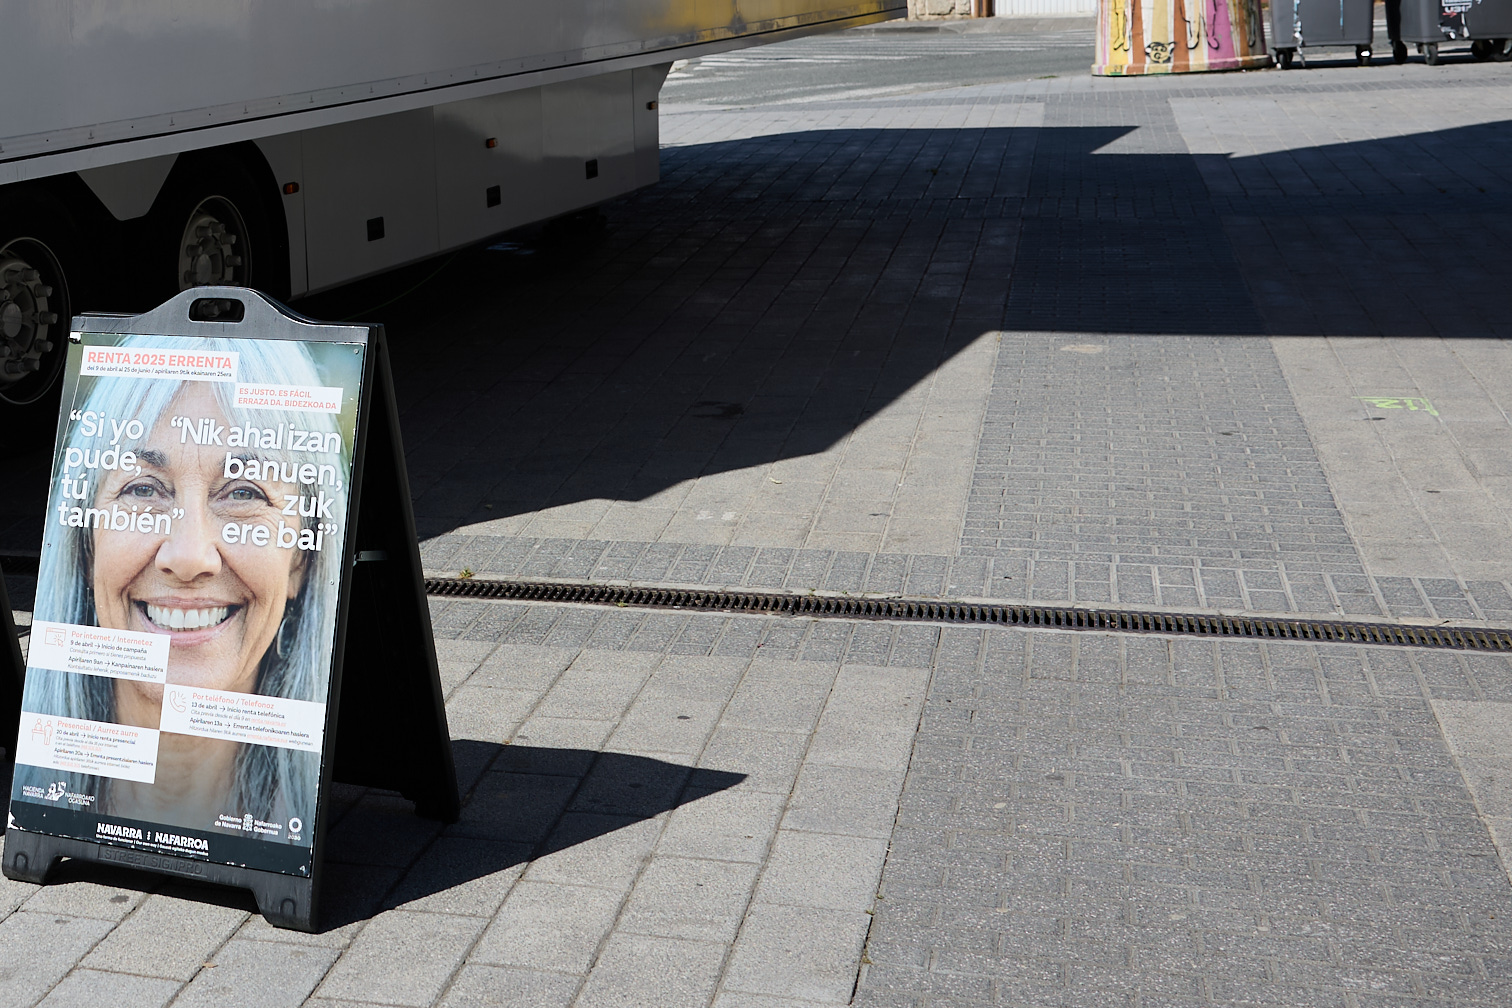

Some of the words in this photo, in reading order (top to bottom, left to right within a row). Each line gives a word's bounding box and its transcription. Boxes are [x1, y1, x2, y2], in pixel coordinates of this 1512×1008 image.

[88, 351, 131, 364] RENTA
[134, 353, 166, 366] 2025
[169, 354, 232, 369] ERRENTA
[238, 396, 269, 405] ERRAZA
[270, 398, 283, 406] DA.
[285, 399, 324, 409] BIDEZKOA
[326, 401, 337, 409] DA
[239, 386, 249, 395] ES
[250, 388, 277, 396] JUSTO.
[279, 389, 288, 397] ES
[290, 389, 312, 398] FÁCIL
[67, 408, 106, 438] “Si
[108, 416, 145, 446] yo
[168, 415, 226, 445] “Nik
[226, 419, 284, 449] ahal
[285, 423, 342, 453] izan
[63, 443, 144, 477] pude,
[223, 451, 345, 490] banuen,
[59, 471, 89, 500] tú
[56, 499, 185, 536] también”
[281, 491, 335, 519] zuk
[220, 519, 270, 547] ere
[275, 519, 338, 552] bai”
[72, 630, 83, 638] Por
[84, 631, 111, 642] internet
[117, 635, 153, 647] Internetez
[193, 691, 204, 700] Por
[205, 694, 235, 704] teléfono
[241, 698, 275, 710] Telefonoz
[57, 719, 92, 731] Presencial
[97, 725, 119, 735] Aurrez
[120, 730, 139, 738] aurre
[97, 823, 143, 839] NAVARRA
[155, 832, 209, 850] NAFARROA
[105, 849, 148, 865] STREET
[151, 857, 202, 874] SIGNPRO
